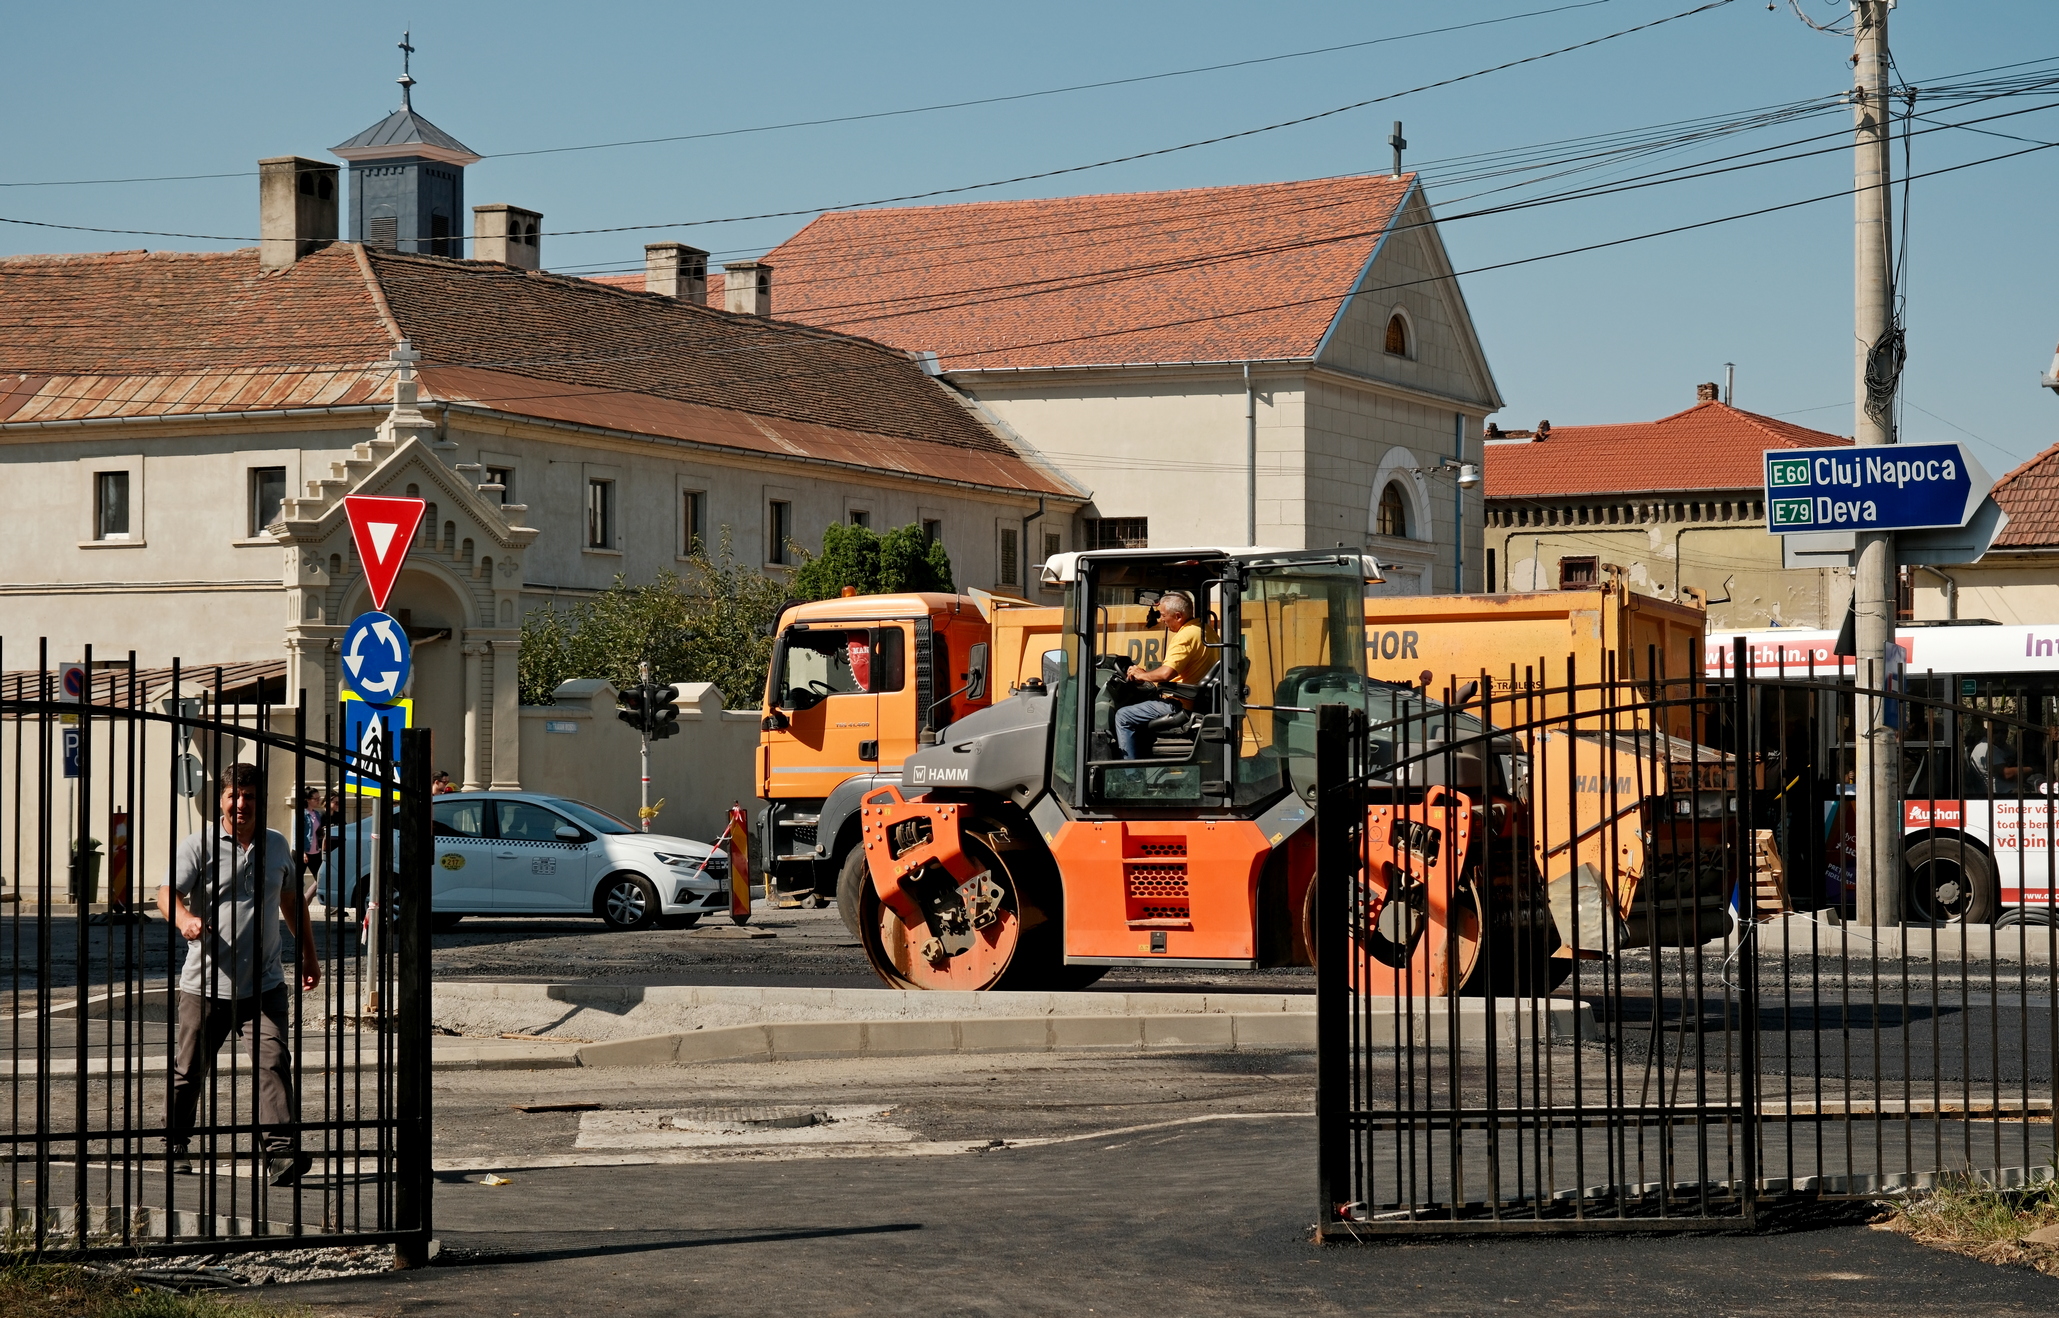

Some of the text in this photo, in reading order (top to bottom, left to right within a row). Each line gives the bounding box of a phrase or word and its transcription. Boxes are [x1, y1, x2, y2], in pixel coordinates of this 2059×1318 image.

[1815, 457, 1862, 488] Cluj
[1866, 456, 1956, 489] Napoca
[1816, 496, 1877, 524] Deva
[2026, 633, 2059, 657] In
[928, 768, 969, 781] HAMM
[1909, 806, 1961, 820] Auhan
[1997, 834, 2016, 848] vă
